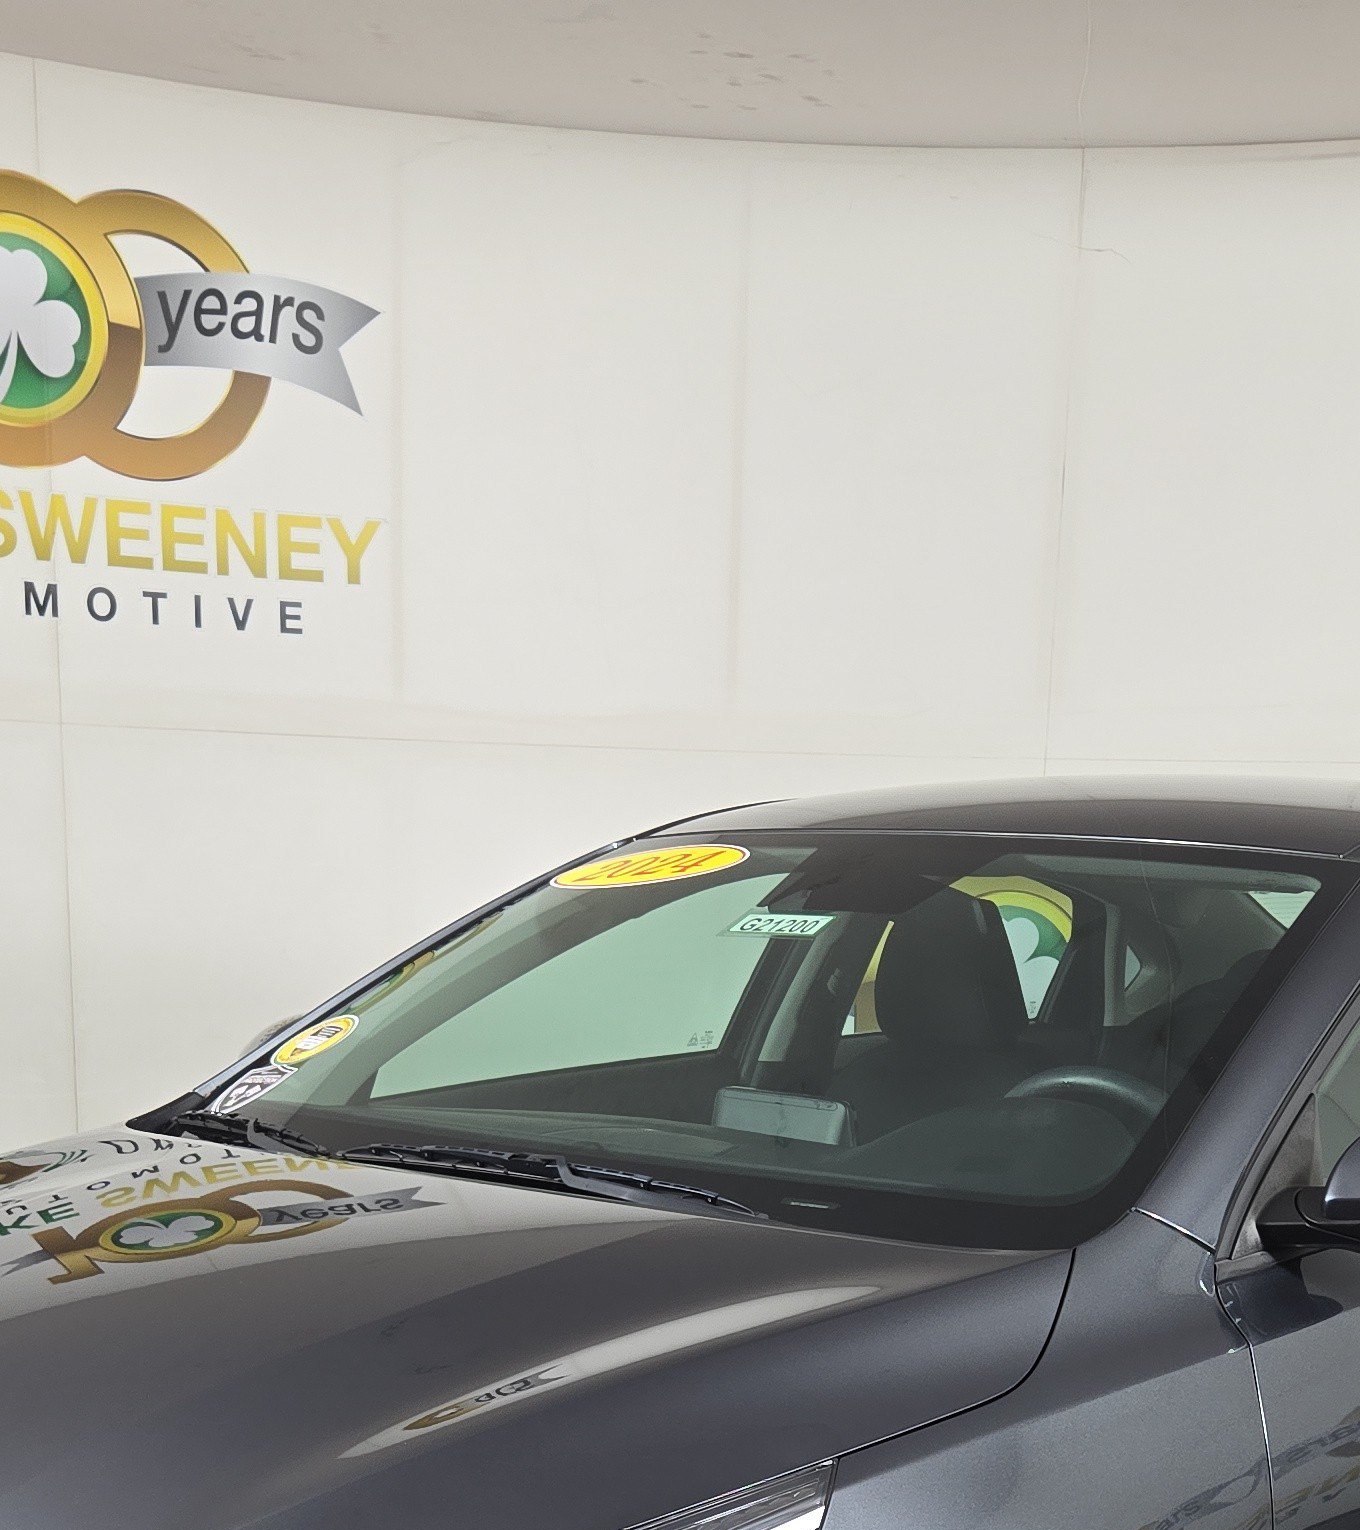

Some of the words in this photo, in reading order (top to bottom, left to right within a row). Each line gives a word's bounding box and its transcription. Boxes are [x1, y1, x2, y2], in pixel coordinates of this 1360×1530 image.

[157, 287, 327, 355] years
[572, 850, 727, 883] 2024
[740, 916, 820, 934] G21200
